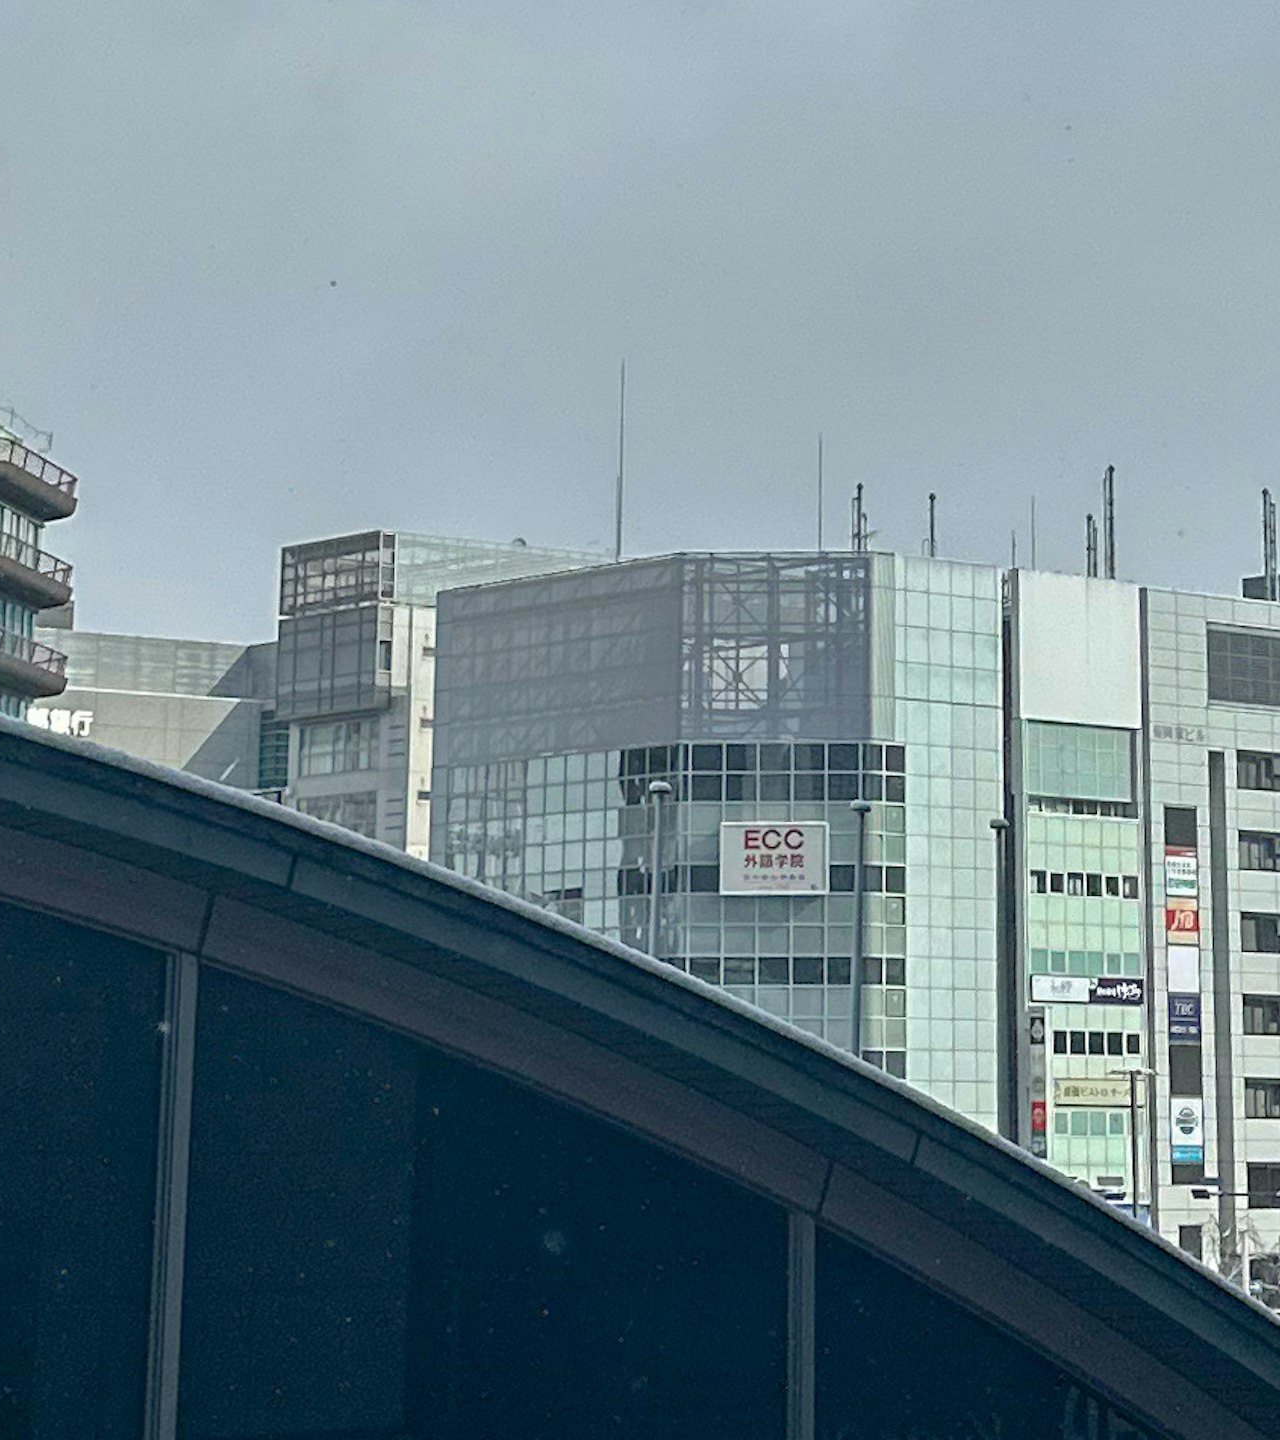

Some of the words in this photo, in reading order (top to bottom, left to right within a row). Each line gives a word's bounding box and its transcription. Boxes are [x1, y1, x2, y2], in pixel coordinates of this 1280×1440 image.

[744, 828, 805, 851] ECC
[744, 854, 805, 869] 外語学院
